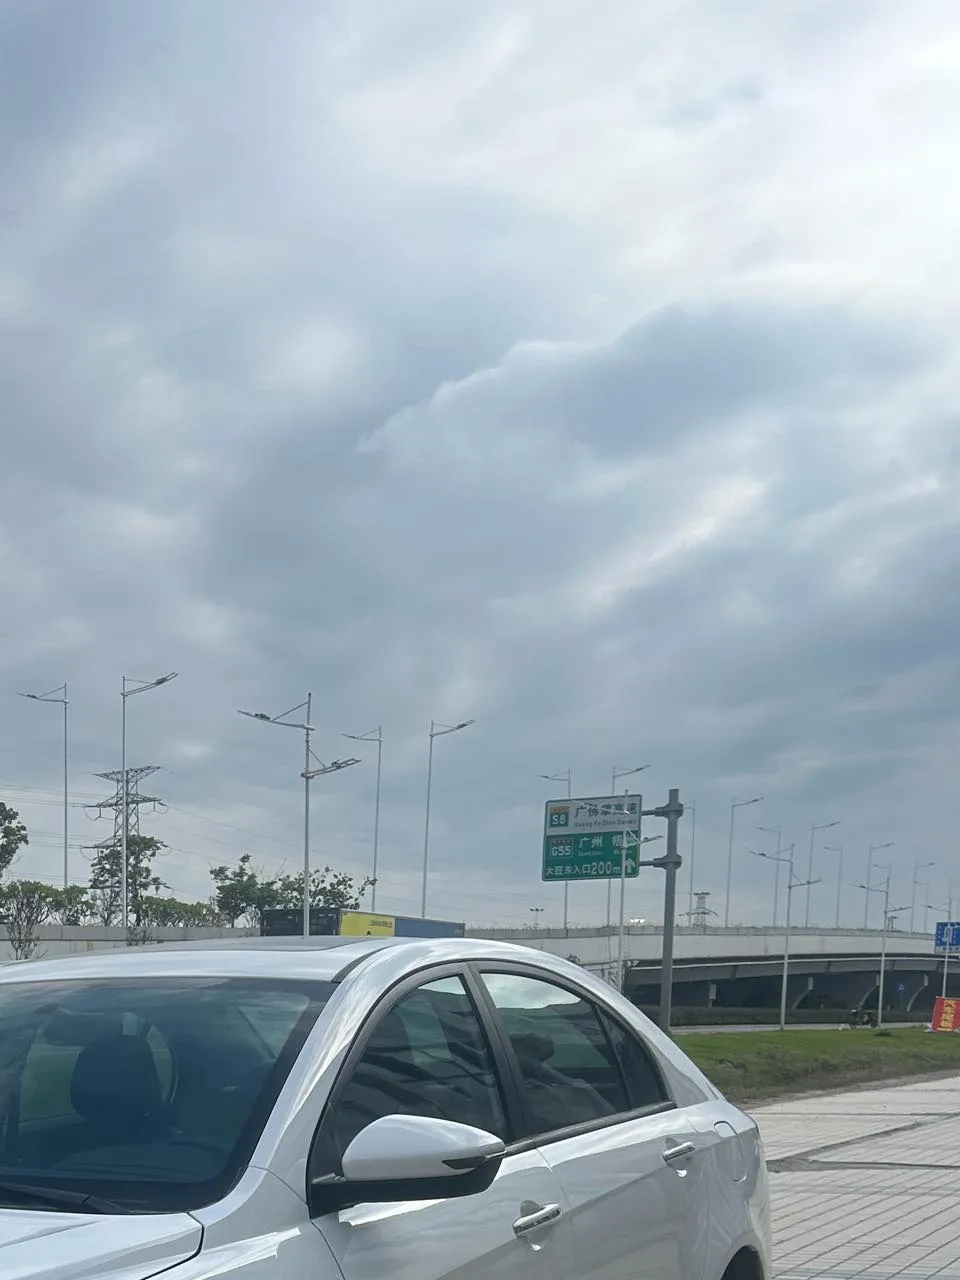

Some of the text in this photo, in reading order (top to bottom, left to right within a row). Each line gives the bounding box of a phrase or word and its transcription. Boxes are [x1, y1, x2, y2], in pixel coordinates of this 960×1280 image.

[552, 814, 566, 825] S8
[580, 836, 603, 848] 广州
[552, 845, 571, 856] G55
